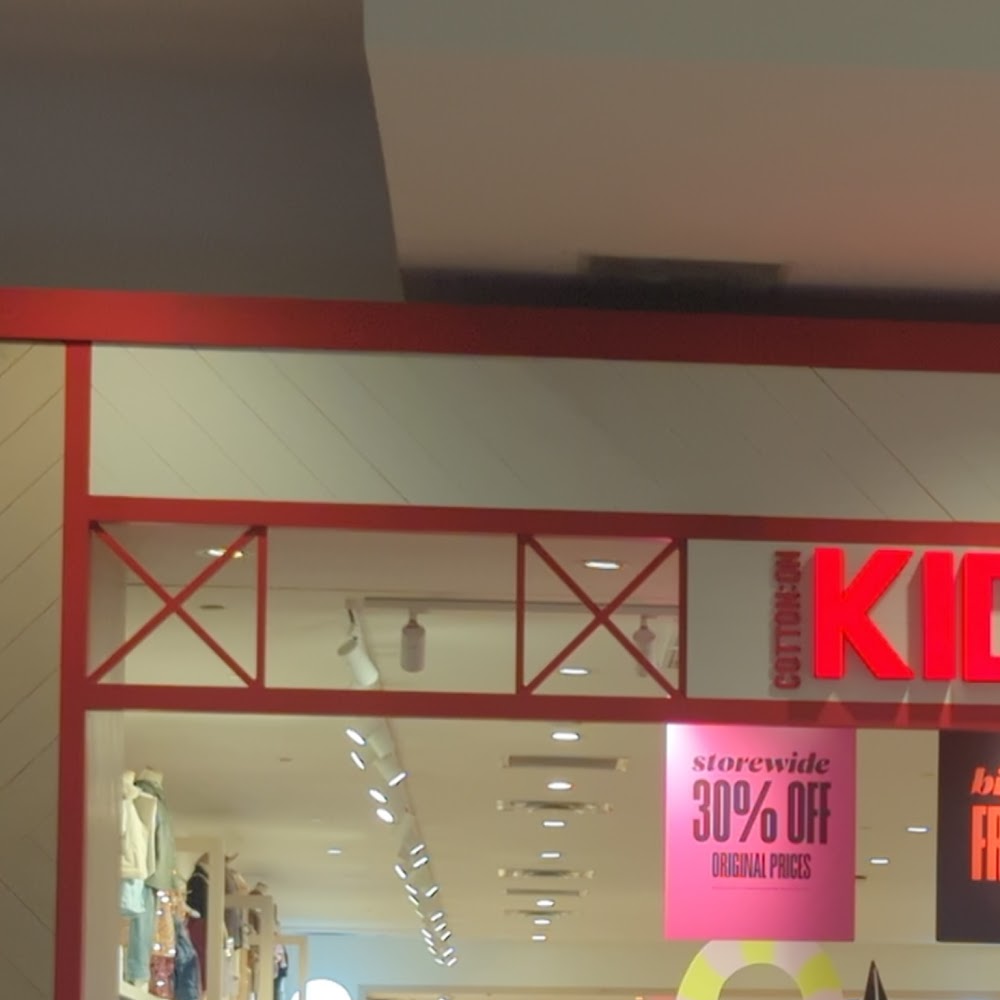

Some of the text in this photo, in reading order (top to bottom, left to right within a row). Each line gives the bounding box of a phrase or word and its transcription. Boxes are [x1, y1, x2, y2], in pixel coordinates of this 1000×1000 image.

[692, 752, 830, 774] storewide
[692, 779, 831, 844] 30% OFF
[712, 852, 811, 880] ORIGINAL PRICES
